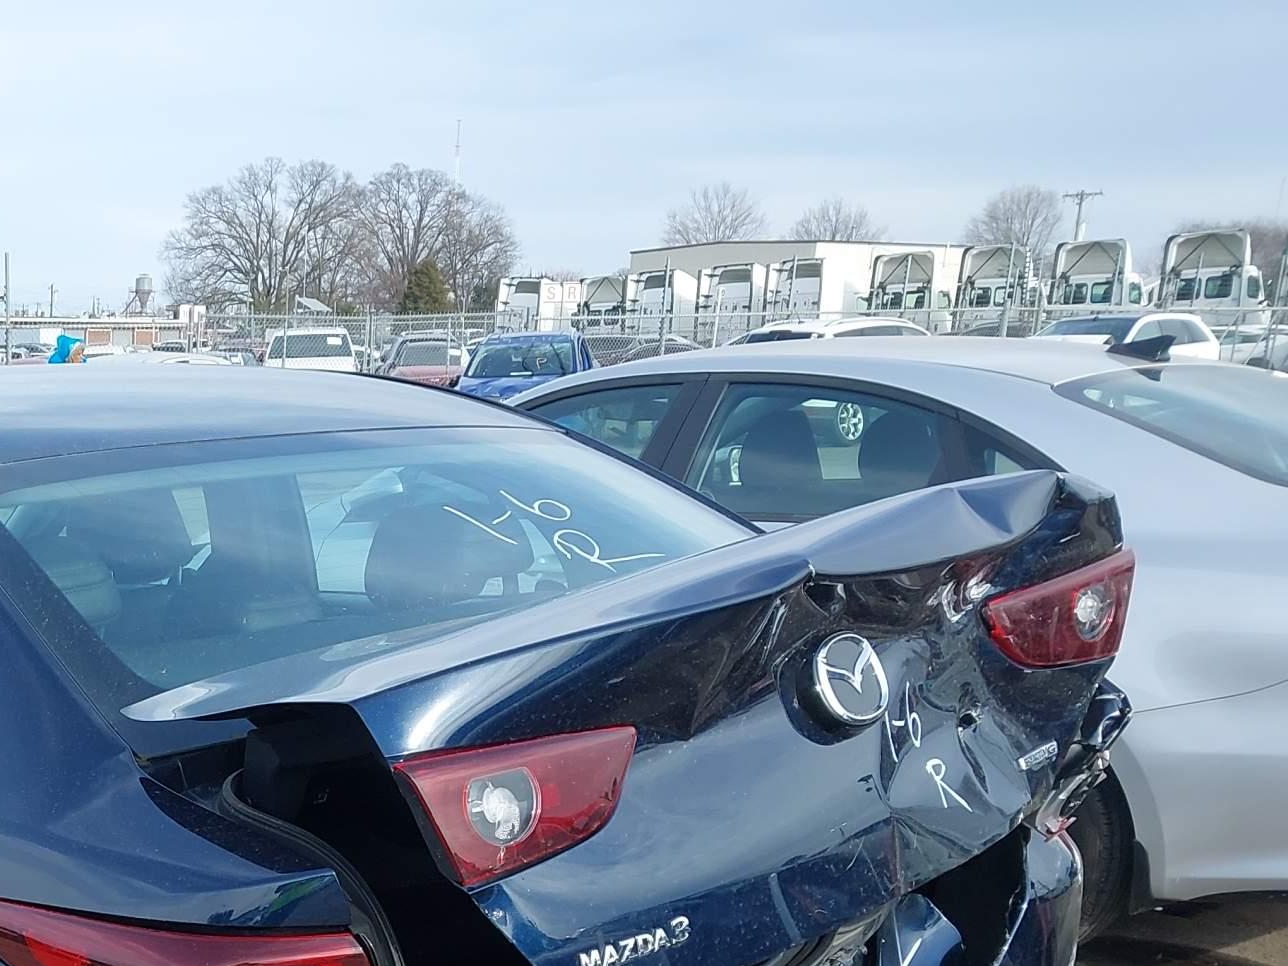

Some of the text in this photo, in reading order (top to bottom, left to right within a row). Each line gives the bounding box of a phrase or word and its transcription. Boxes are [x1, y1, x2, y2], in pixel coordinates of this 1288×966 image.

[546, 286, 557, 300] S
[567, 286, 577, 300] R
[442, 489, 571, 545] 1-6
[885, 680, 922, 763] 1-6
[925, 758, 974, 812] R
